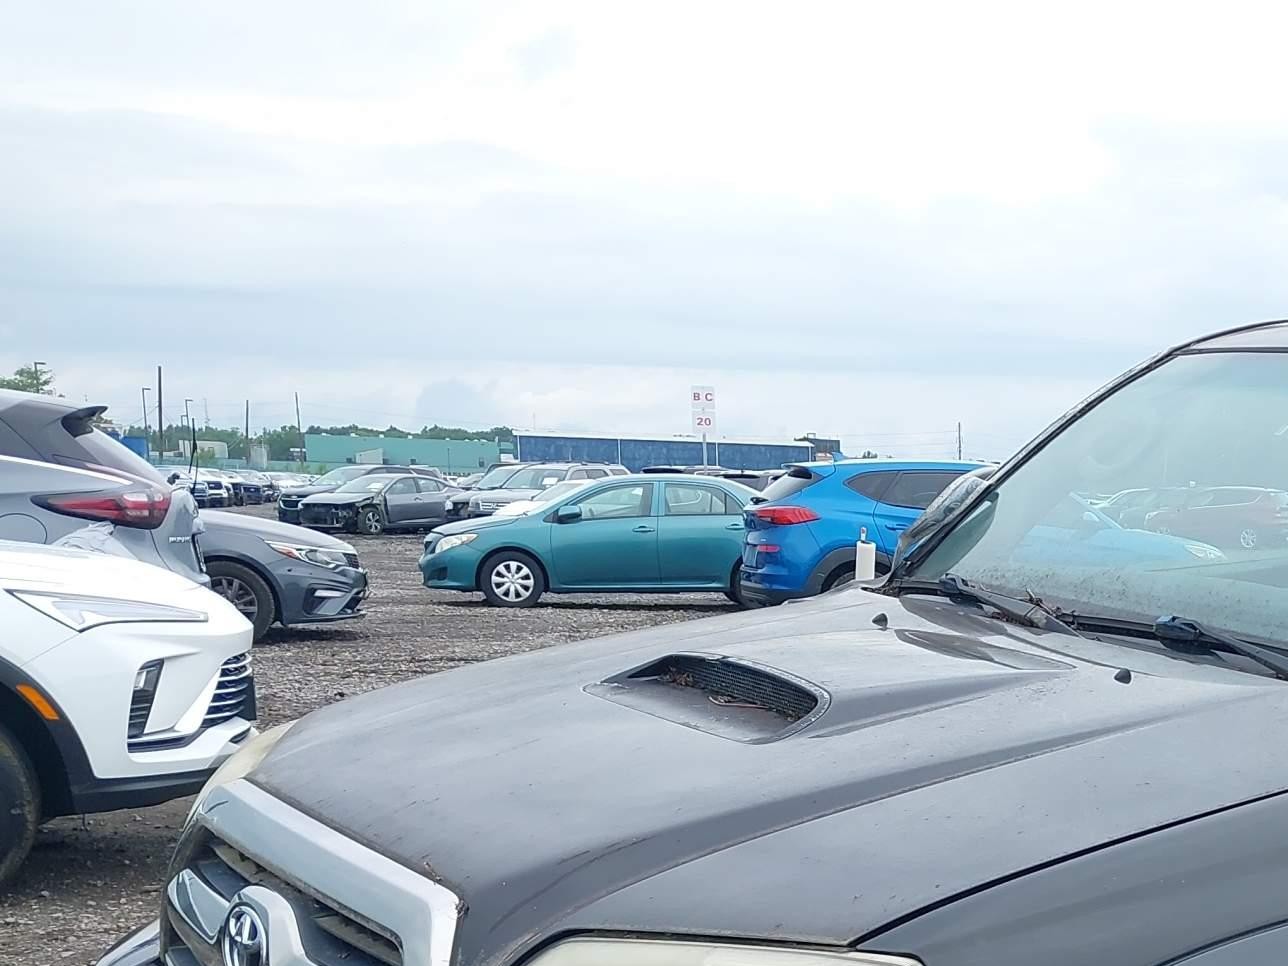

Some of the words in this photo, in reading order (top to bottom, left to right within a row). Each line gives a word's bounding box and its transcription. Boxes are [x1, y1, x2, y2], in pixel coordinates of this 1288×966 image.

[693, 392, 701, 401] B
[705, 392, 713, 402] C
[696, 417, 712, 426] 20
